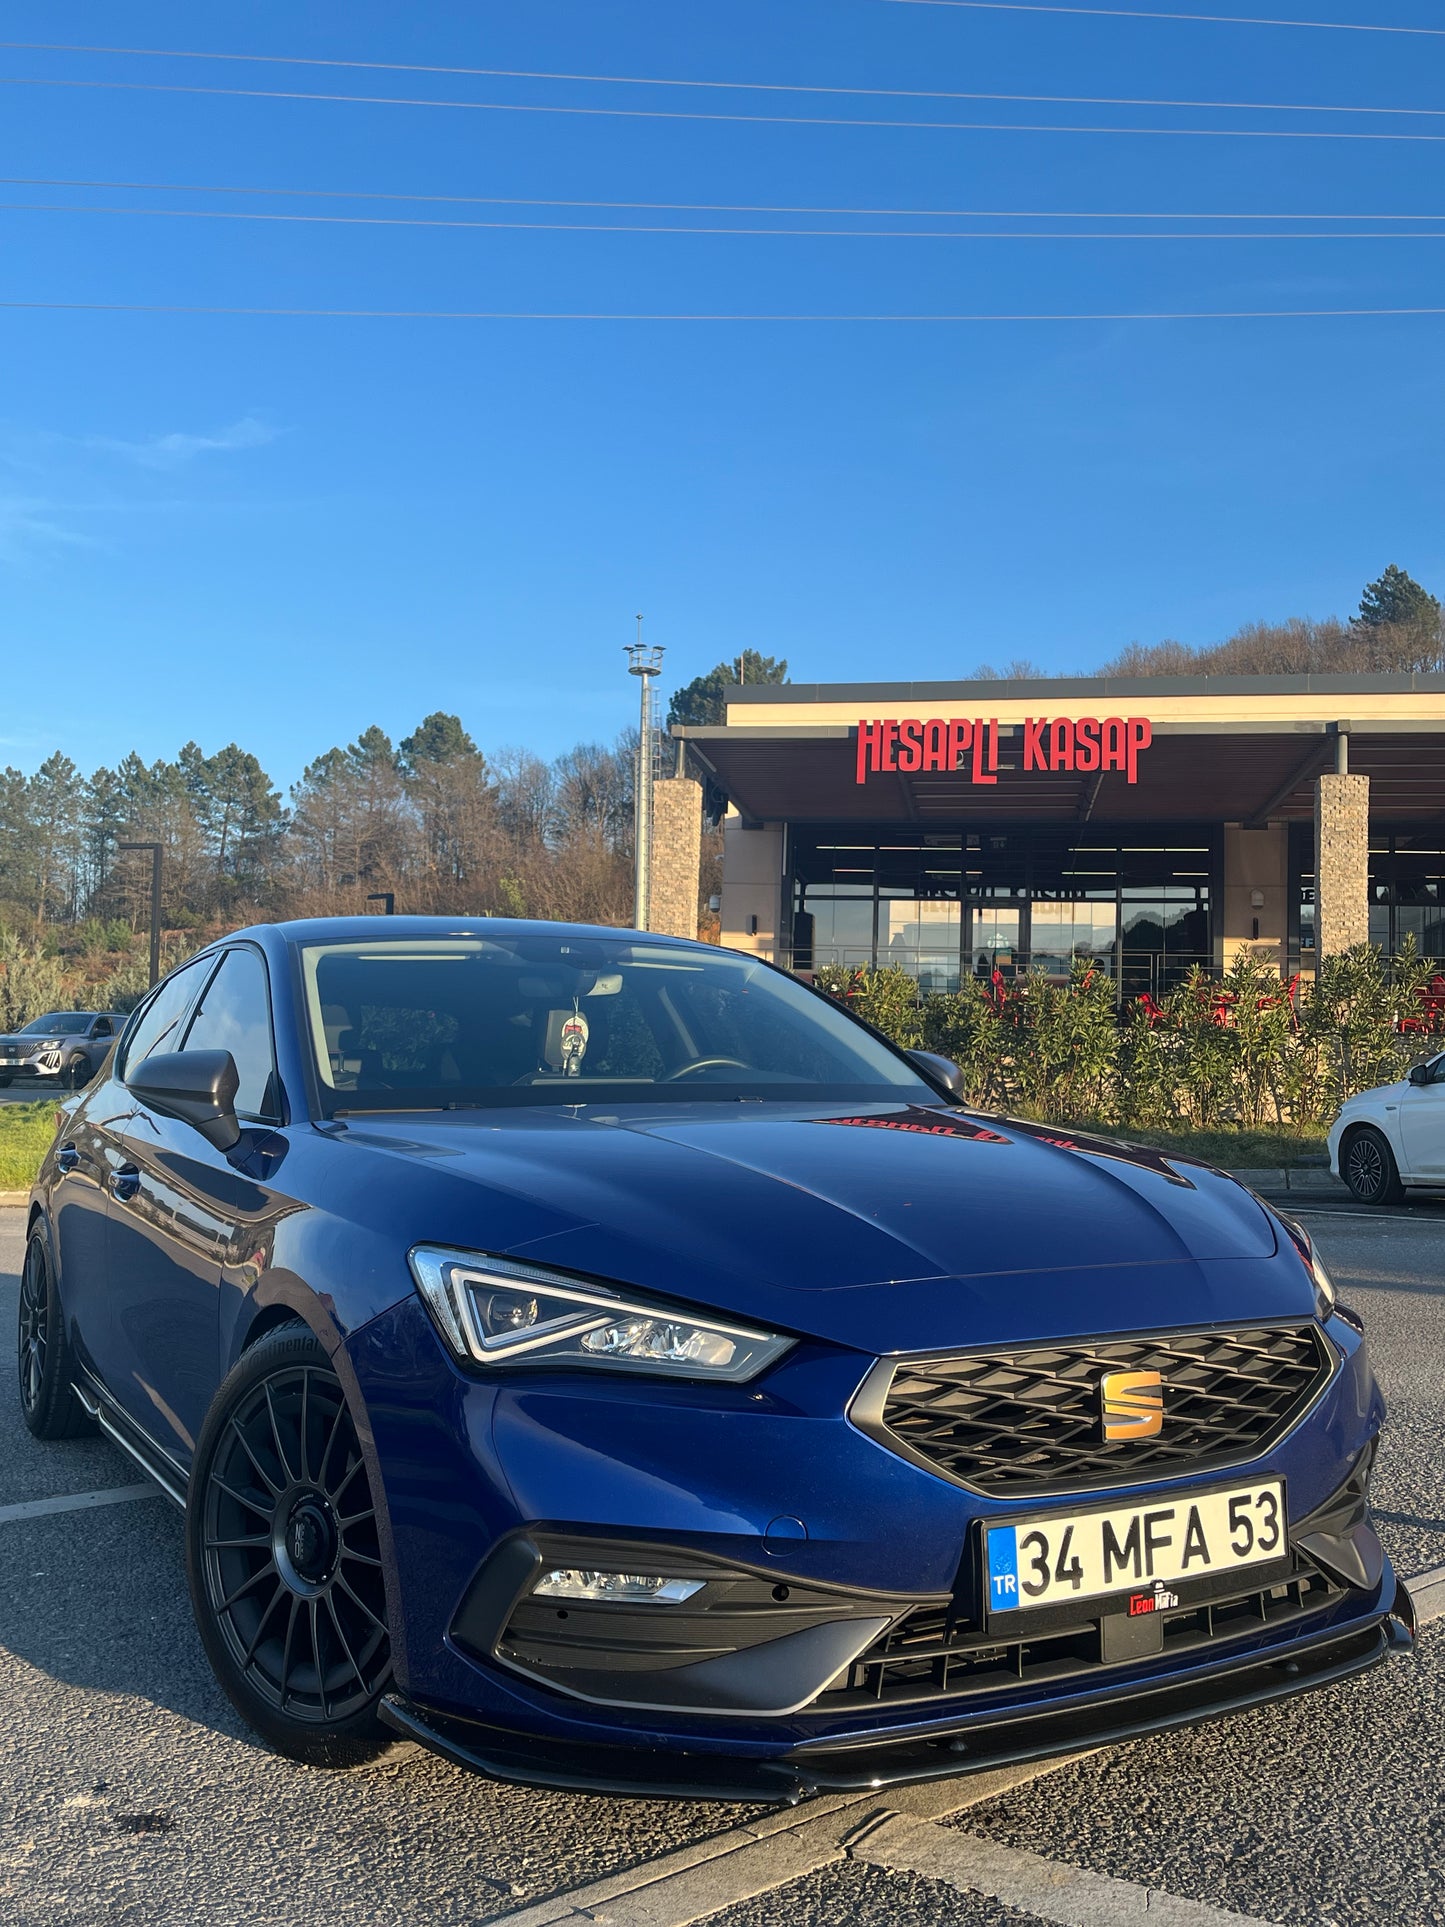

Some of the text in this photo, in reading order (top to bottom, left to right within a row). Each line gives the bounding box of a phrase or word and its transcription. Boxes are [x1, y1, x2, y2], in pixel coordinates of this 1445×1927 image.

[856, 717, 1152, 785] HESAPLI KASAP
[1020, 1491, 1280, 1597] 34 MFA 53
[993, 1574, 1016, 1595] TR
